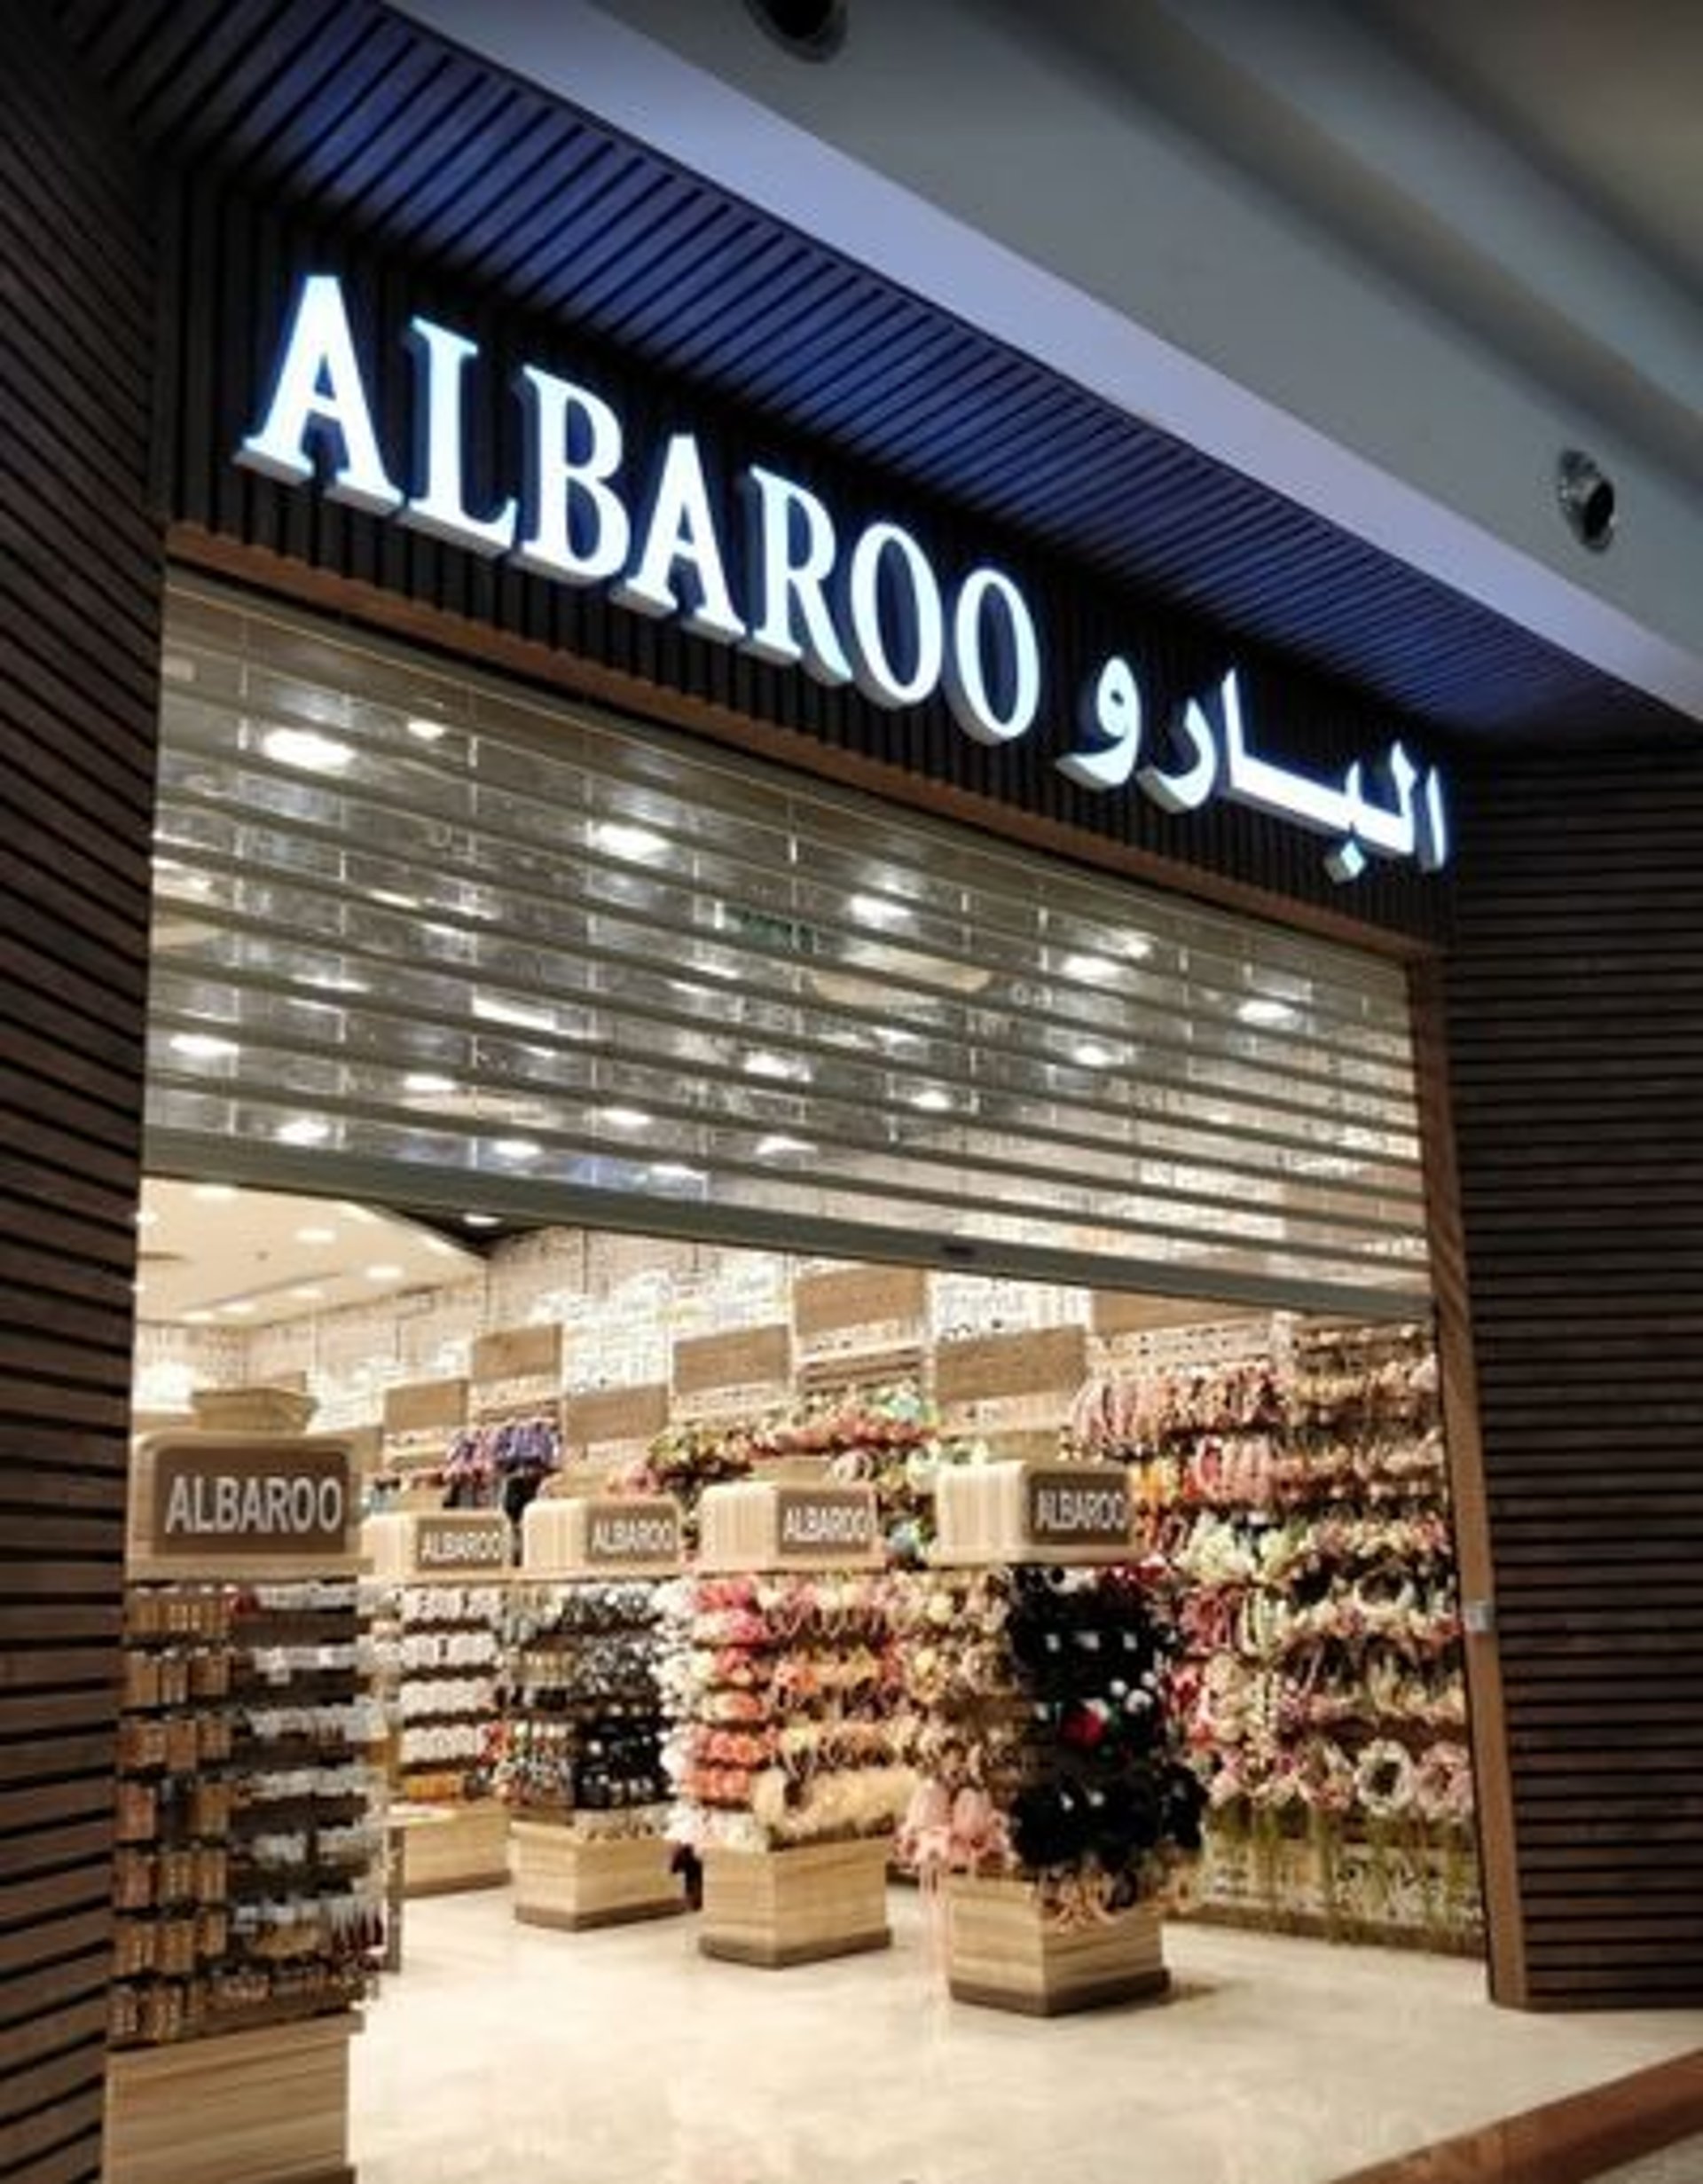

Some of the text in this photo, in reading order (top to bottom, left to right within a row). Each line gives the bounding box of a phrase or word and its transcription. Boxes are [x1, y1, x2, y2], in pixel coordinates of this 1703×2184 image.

[236, 275, 1040, 743] ALBAROO
[1057, 656, 1448, 883] البارو
[164, 1475, 342, 1535] ALBAROO
[782, 1506, 873, 1543] ALBAROO
[1034, 1489, 1126, 1530] ALBAROO
[420, 1532, 502, 1562] ALBAROO
[592, 1518, 674, 1554] ALBAROO
